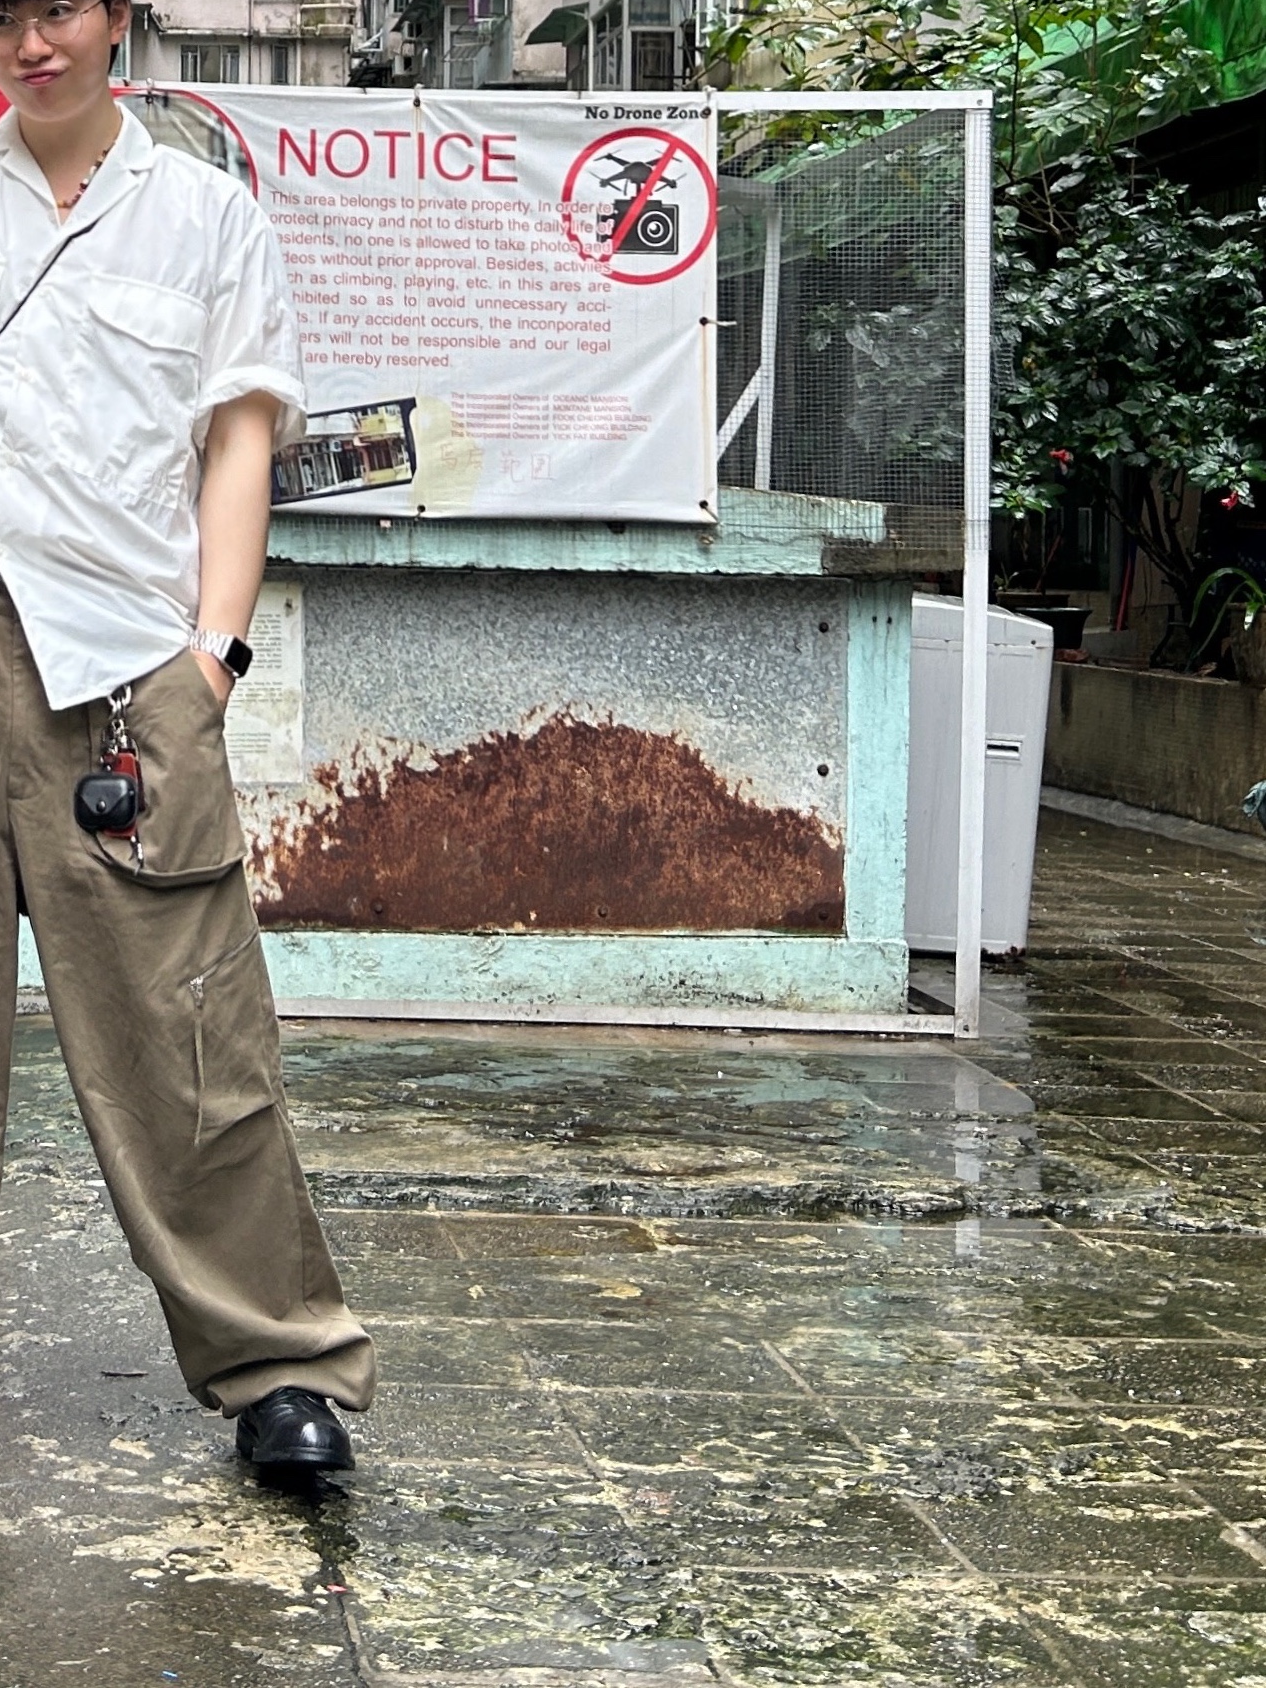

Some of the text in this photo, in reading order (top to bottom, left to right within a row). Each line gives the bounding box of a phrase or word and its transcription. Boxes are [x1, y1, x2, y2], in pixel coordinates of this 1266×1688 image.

[585, 106, 609, 119] No
[614, 106, 662, 119] Drone
[277, 127, 518, 183] NOTICE
[271, 191, 300, 205] This
[304, 195, 336, 207] area
[340, 194, 396, 211] belongs
[401, 196, 414, 209] to
[418, 197, 467, 214] private
[538, 200, 551, 212] In
[556, 201, 595, 213] order
[324, 215, 374, 230] privacy
[379, 216, 405, 228] and
[410, 218, 432, 229] not
[437, 217, 450, 229] to
[455, 217, 503, 230] disturb
[508, 218, 529, 230] the
[534, 218, 568, 235] daily
[572, 219, 593, 233] life
[598, 220, 613, 234] of
[277, 232, 612, 257] esidents, no one is allowed to take photos and
[283, 252, 316, 264] deos
[321, 253, 372, 266] without
[377, 255, 411, 269] prior
[415, 256, 481, 273] approval.
[486, 257, 549, 273] Besides,
[287, 272, 303, 284] ch
[310, 274, 327, 285] as
[499, 278, 511, 290] in
[518, 278, 543, 291] this
[549, 281, 581, 292] ares
[588, 282, 612, 293] are
[292, 291, 612, 314] hibited so as to avoid unnecessary acci-
[319, 311, 328, 323] If
[333, 313, 359, 328] any
[365, 313, 425, 326] accident
[431, 316, 484, 330] occurs,
[489, 316, 512, 329] the
[299, 331, 611, 354] ers will not be responsible and our legal
[305, 352, 328, 363] are
[333, 351, 382, 368] hereby
